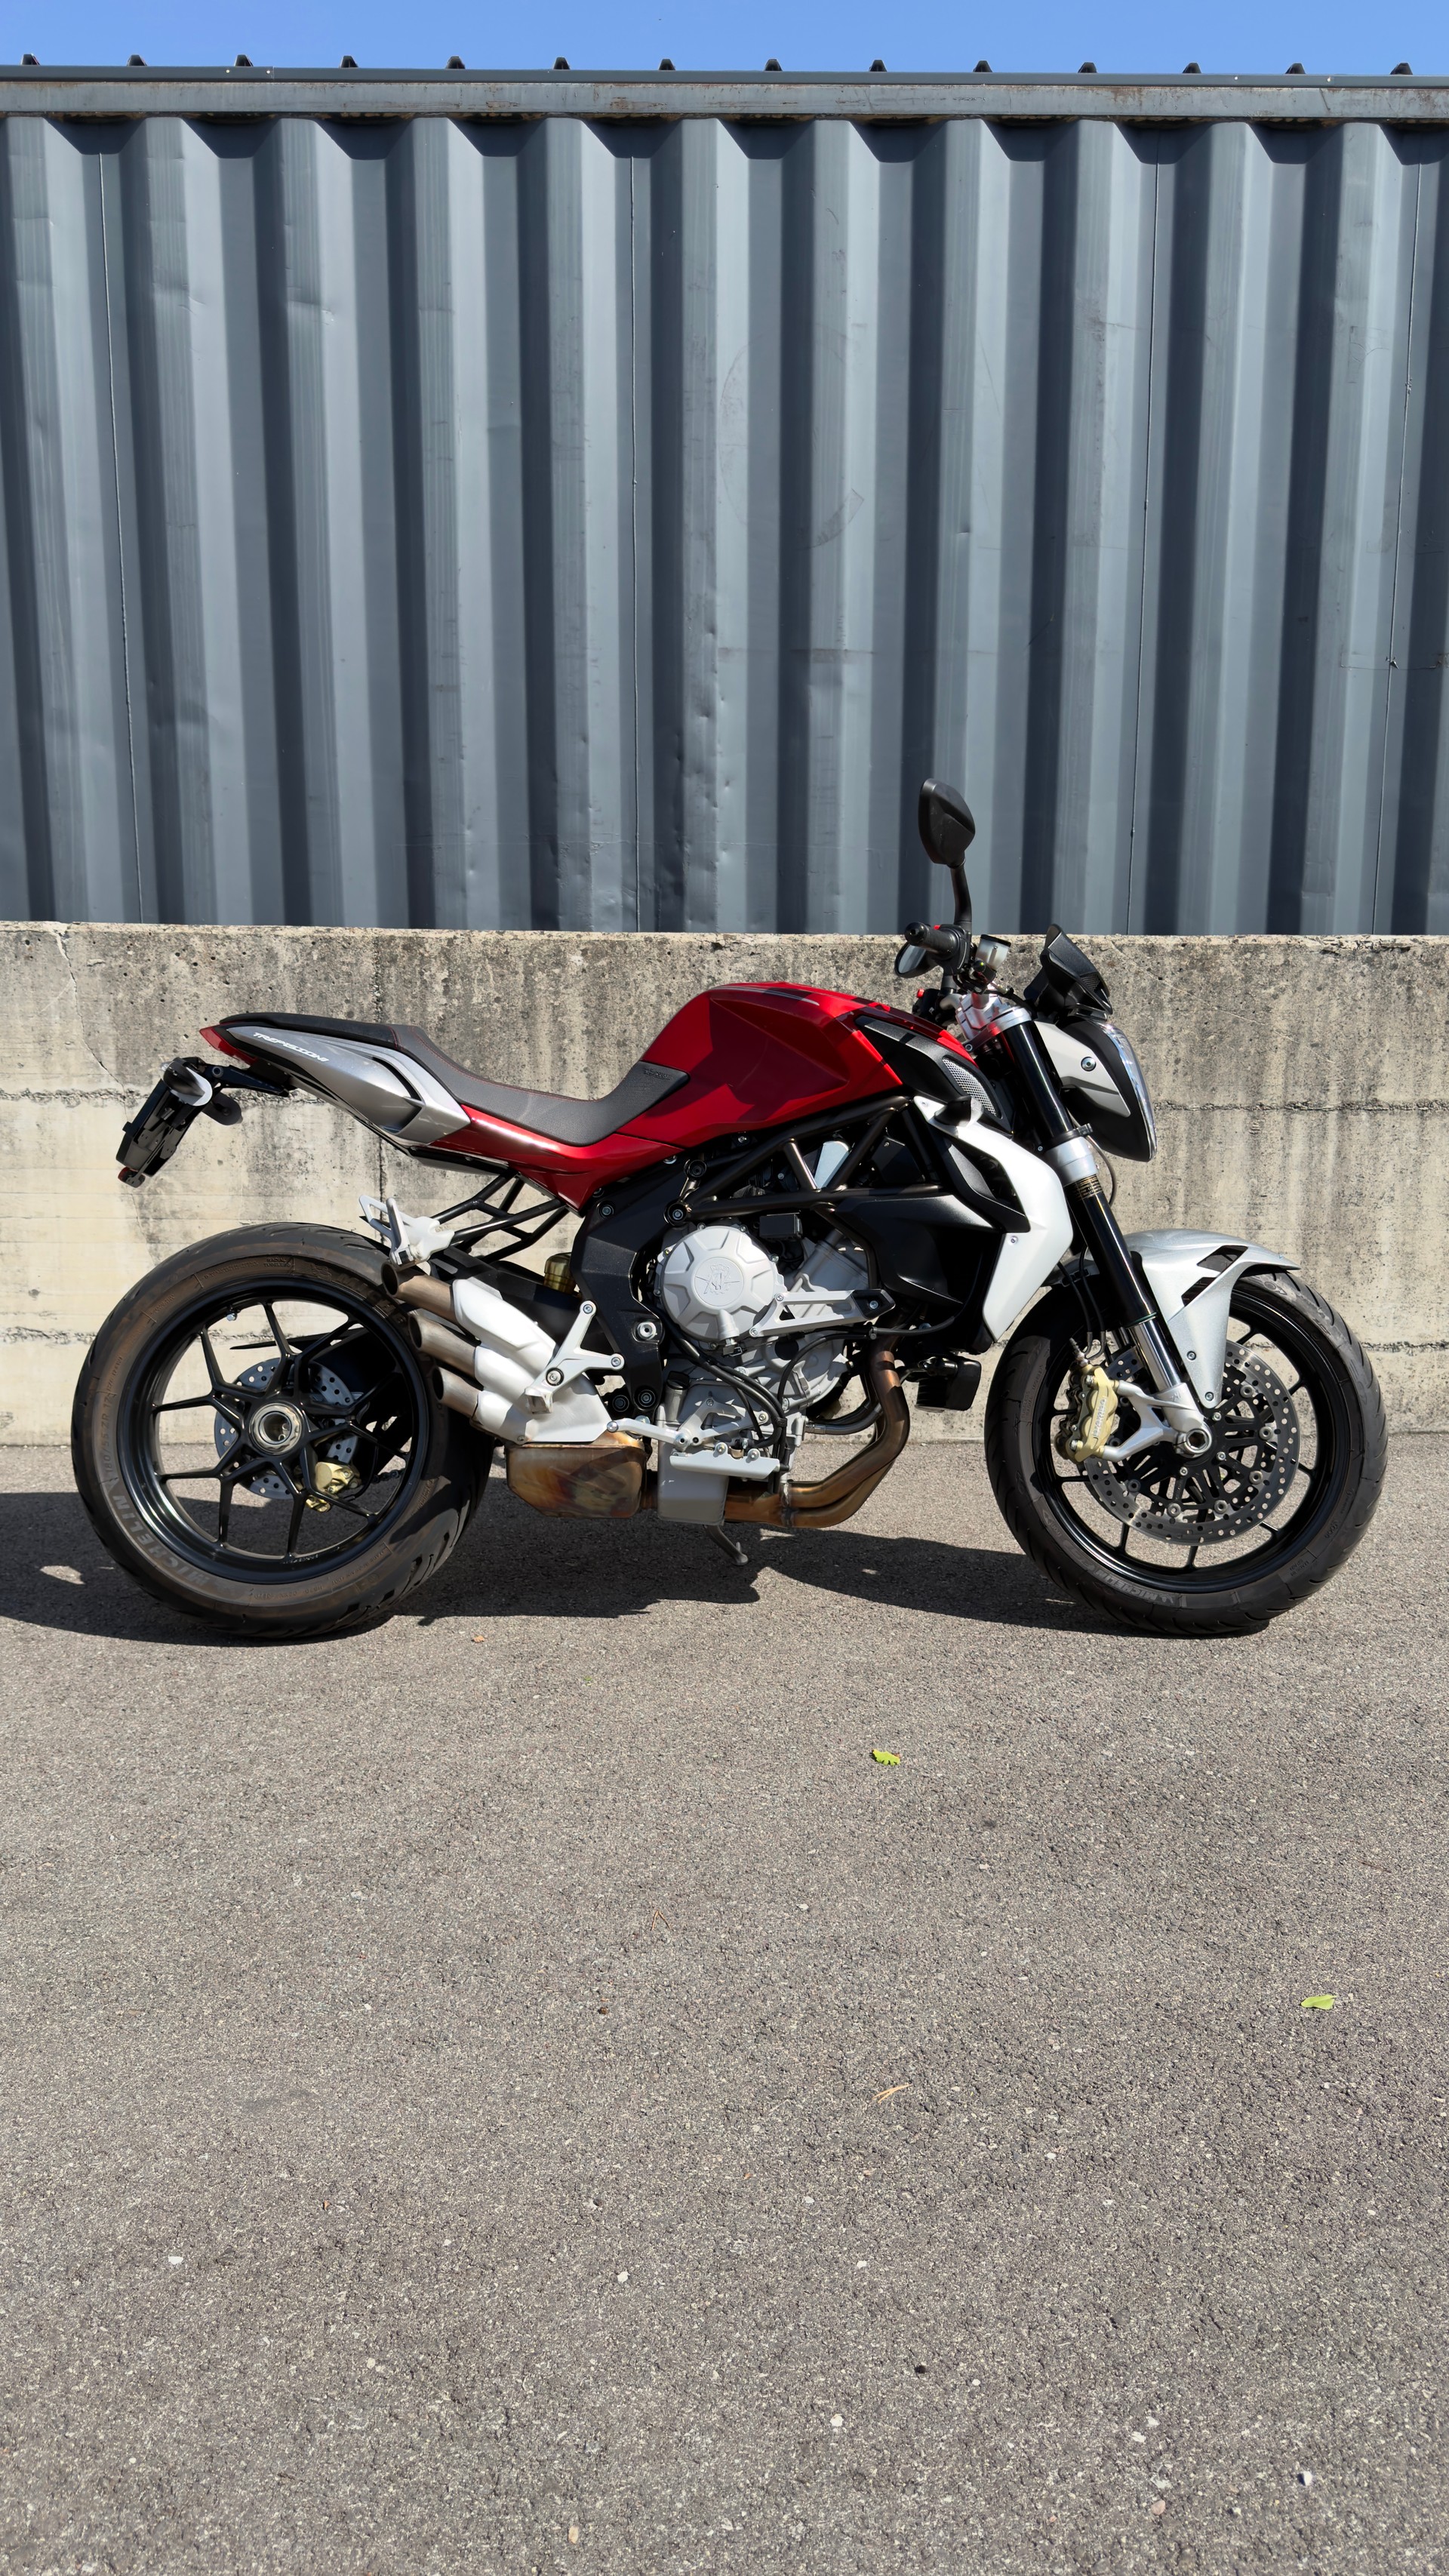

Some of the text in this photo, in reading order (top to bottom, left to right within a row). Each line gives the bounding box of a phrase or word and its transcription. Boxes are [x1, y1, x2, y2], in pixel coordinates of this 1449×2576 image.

[101, 1414, 110, 1426] ZR
[1093, 1398, 1106, 1439] brembo
[103, 1432, 112, 1473] 180/55
[112, 1495, 211, 1585] MICHELIN
[1095, 1568, 1158, 1602] MICHELIN
